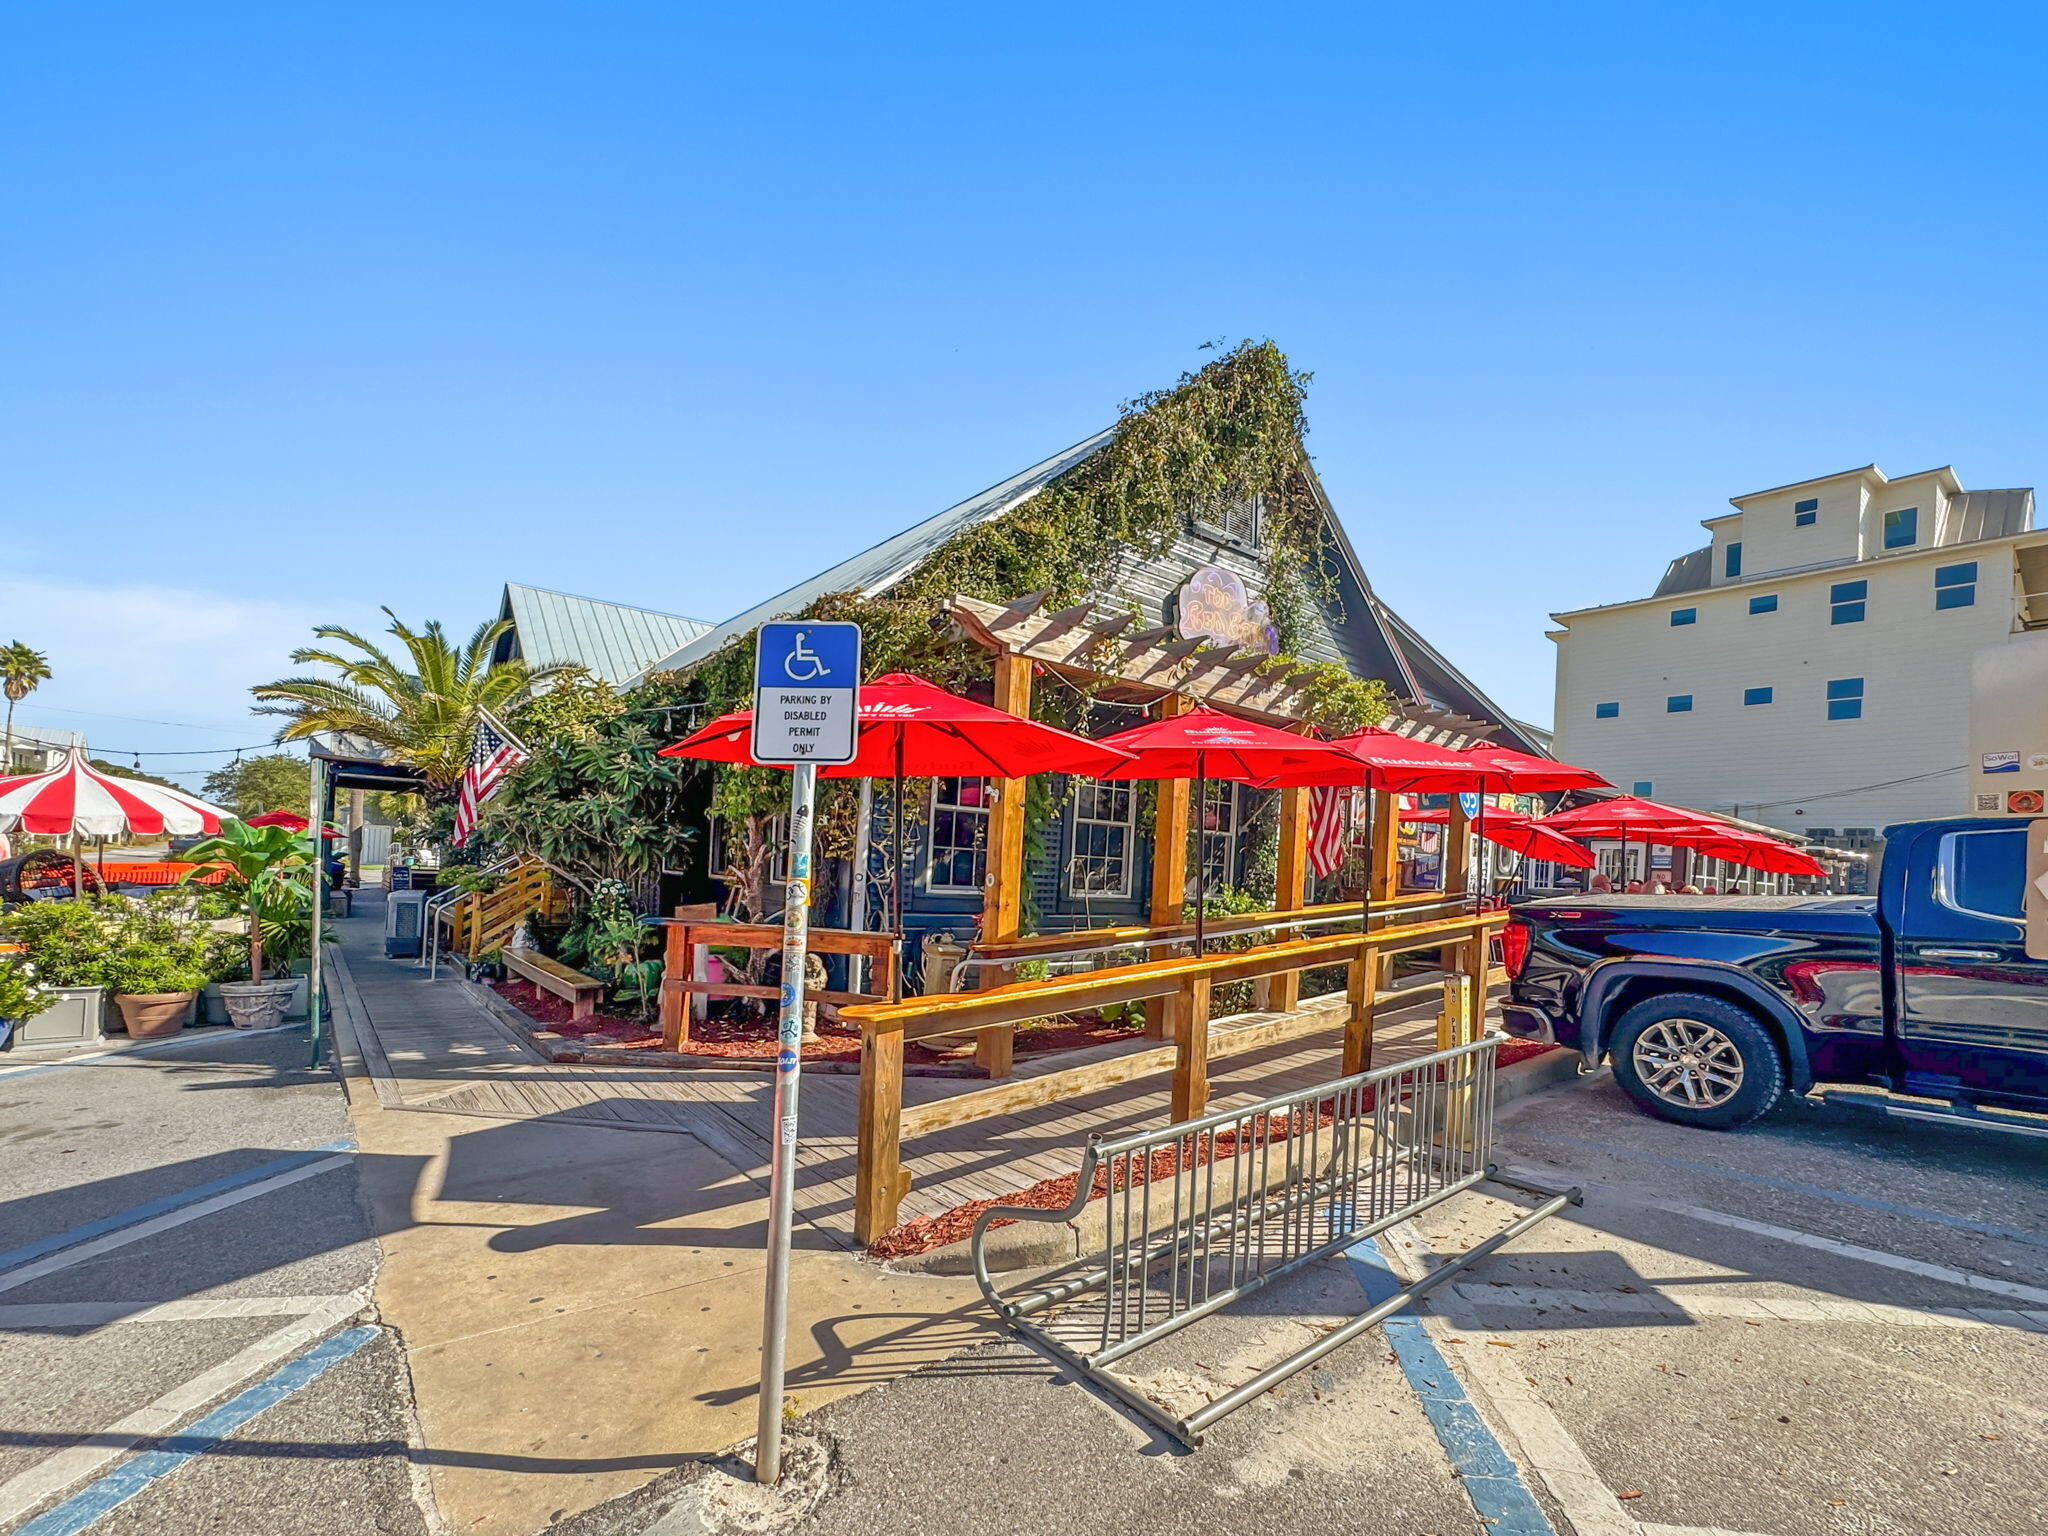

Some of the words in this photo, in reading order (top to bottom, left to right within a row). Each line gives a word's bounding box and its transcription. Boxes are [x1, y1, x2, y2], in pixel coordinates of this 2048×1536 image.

[780, 695, 816, 705] PARKING
[820, 695, 832, 705] BY
[784, 711, 827, 720] DISABLED
[788, 727, 820, 736] PERMIT
[793, 743, 815, 753] ONLY
[1984, 753, 2017, 761] SoWal
[1368, 756, 1474, 768] Budweiser
